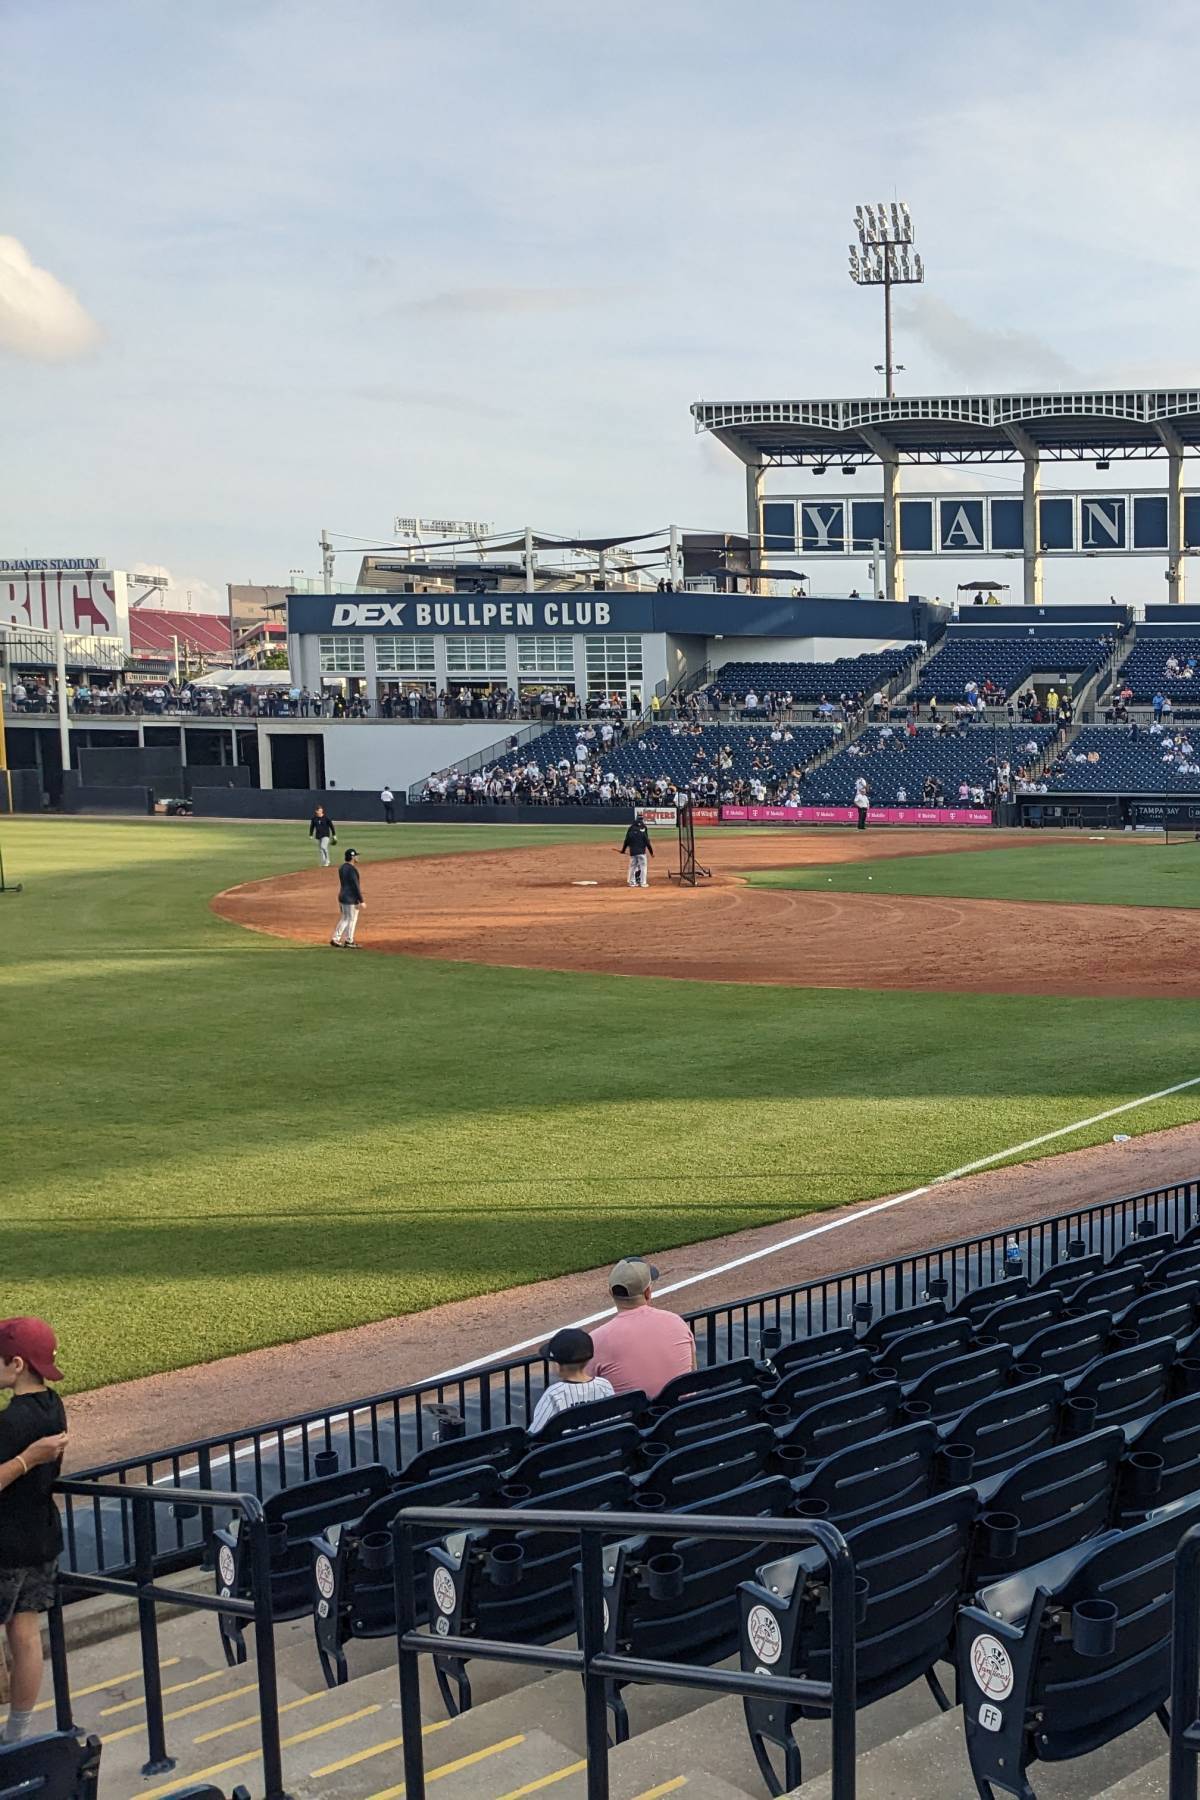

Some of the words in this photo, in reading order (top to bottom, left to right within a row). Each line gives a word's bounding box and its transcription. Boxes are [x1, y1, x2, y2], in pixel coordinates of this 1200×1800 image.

[12, 560, 48, 570] JAMES
[50, 559, 99, 570] STADIUM
[0, 569, 116, 635] BUCS
[331, 603, 407, 627] DEX
[416, 603, 534, 626] BULLPEN
[544, 602, 611, 626] CLUB
[983, 1708, 998, 1726] FF
